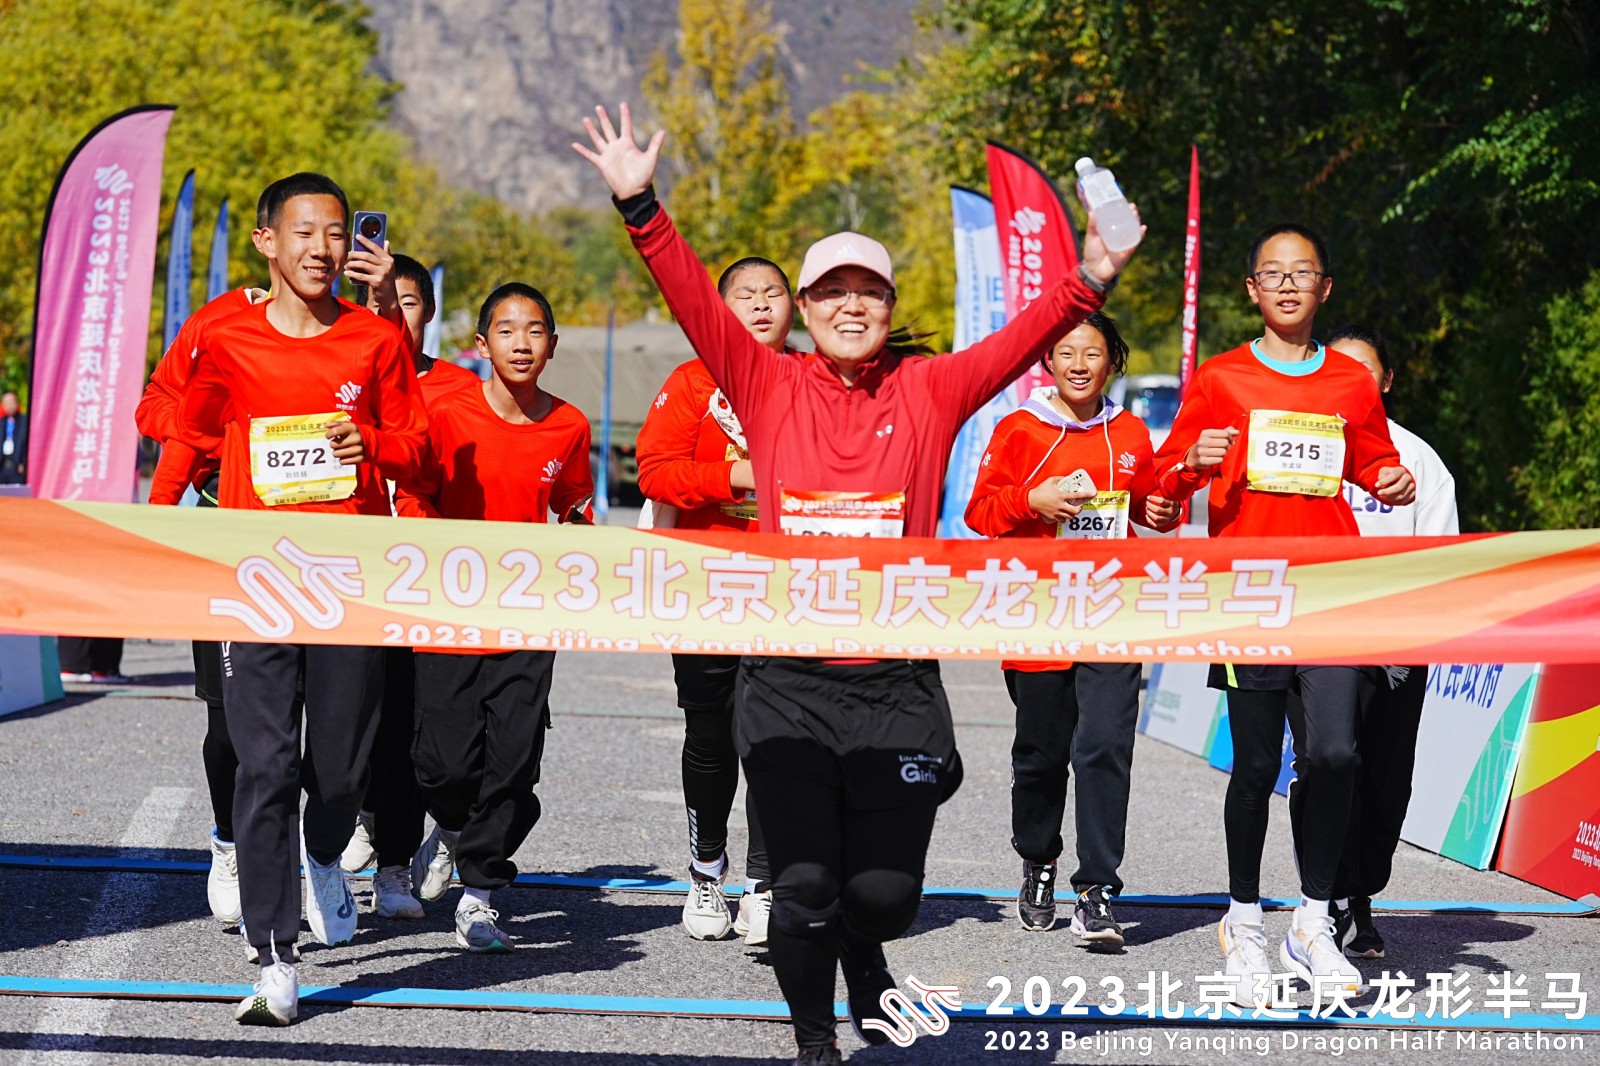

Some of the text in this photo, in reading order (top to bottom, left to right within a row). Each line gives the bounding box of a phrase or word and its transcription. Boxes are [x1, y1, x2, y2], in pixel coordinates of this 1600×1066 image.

[1021, 237, 1043, 310] 2023
[267, 448, 326, 468] 8272
[1265, 441, 1320, 460] 8215
[1068, 516, 1115, 531] 8267
[384, 543, 1297, 630] 2023北京延庆龙形半马
[381, 623, 1293, 657] 2023 Beijing Yanqing Dragon Half Marathon
[901, 762, 938, 784] Girls
